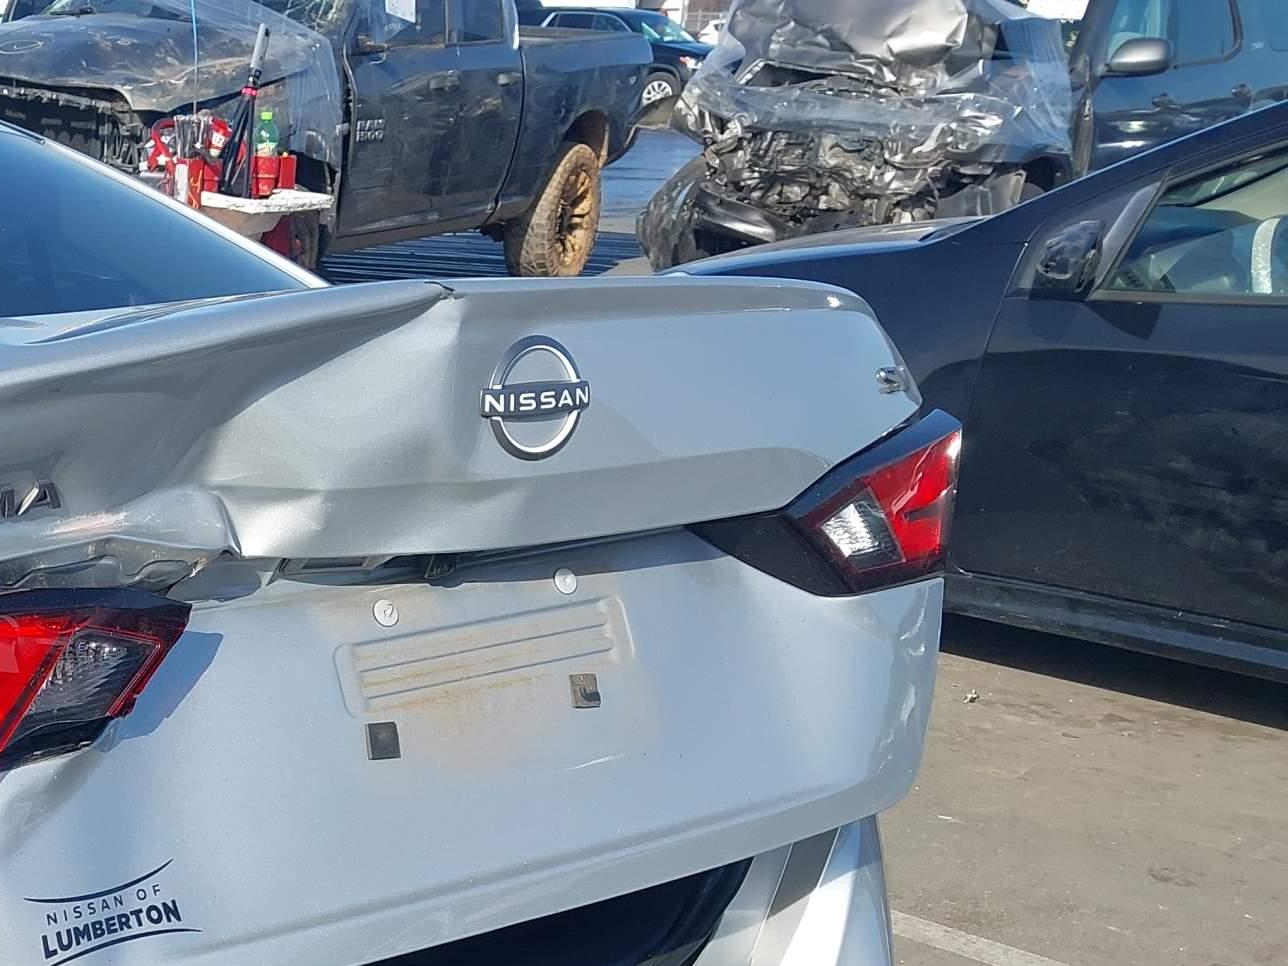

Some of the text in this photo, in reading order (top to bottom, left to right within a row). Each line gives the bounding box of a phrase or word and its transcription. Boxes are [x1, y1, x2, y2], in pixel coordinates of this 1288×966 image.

[484, 386, 589, 412] NISSAN
[46, 884, 161, 926] NISSAN OF
[41, 899, 182, 959] LUMBERTON
